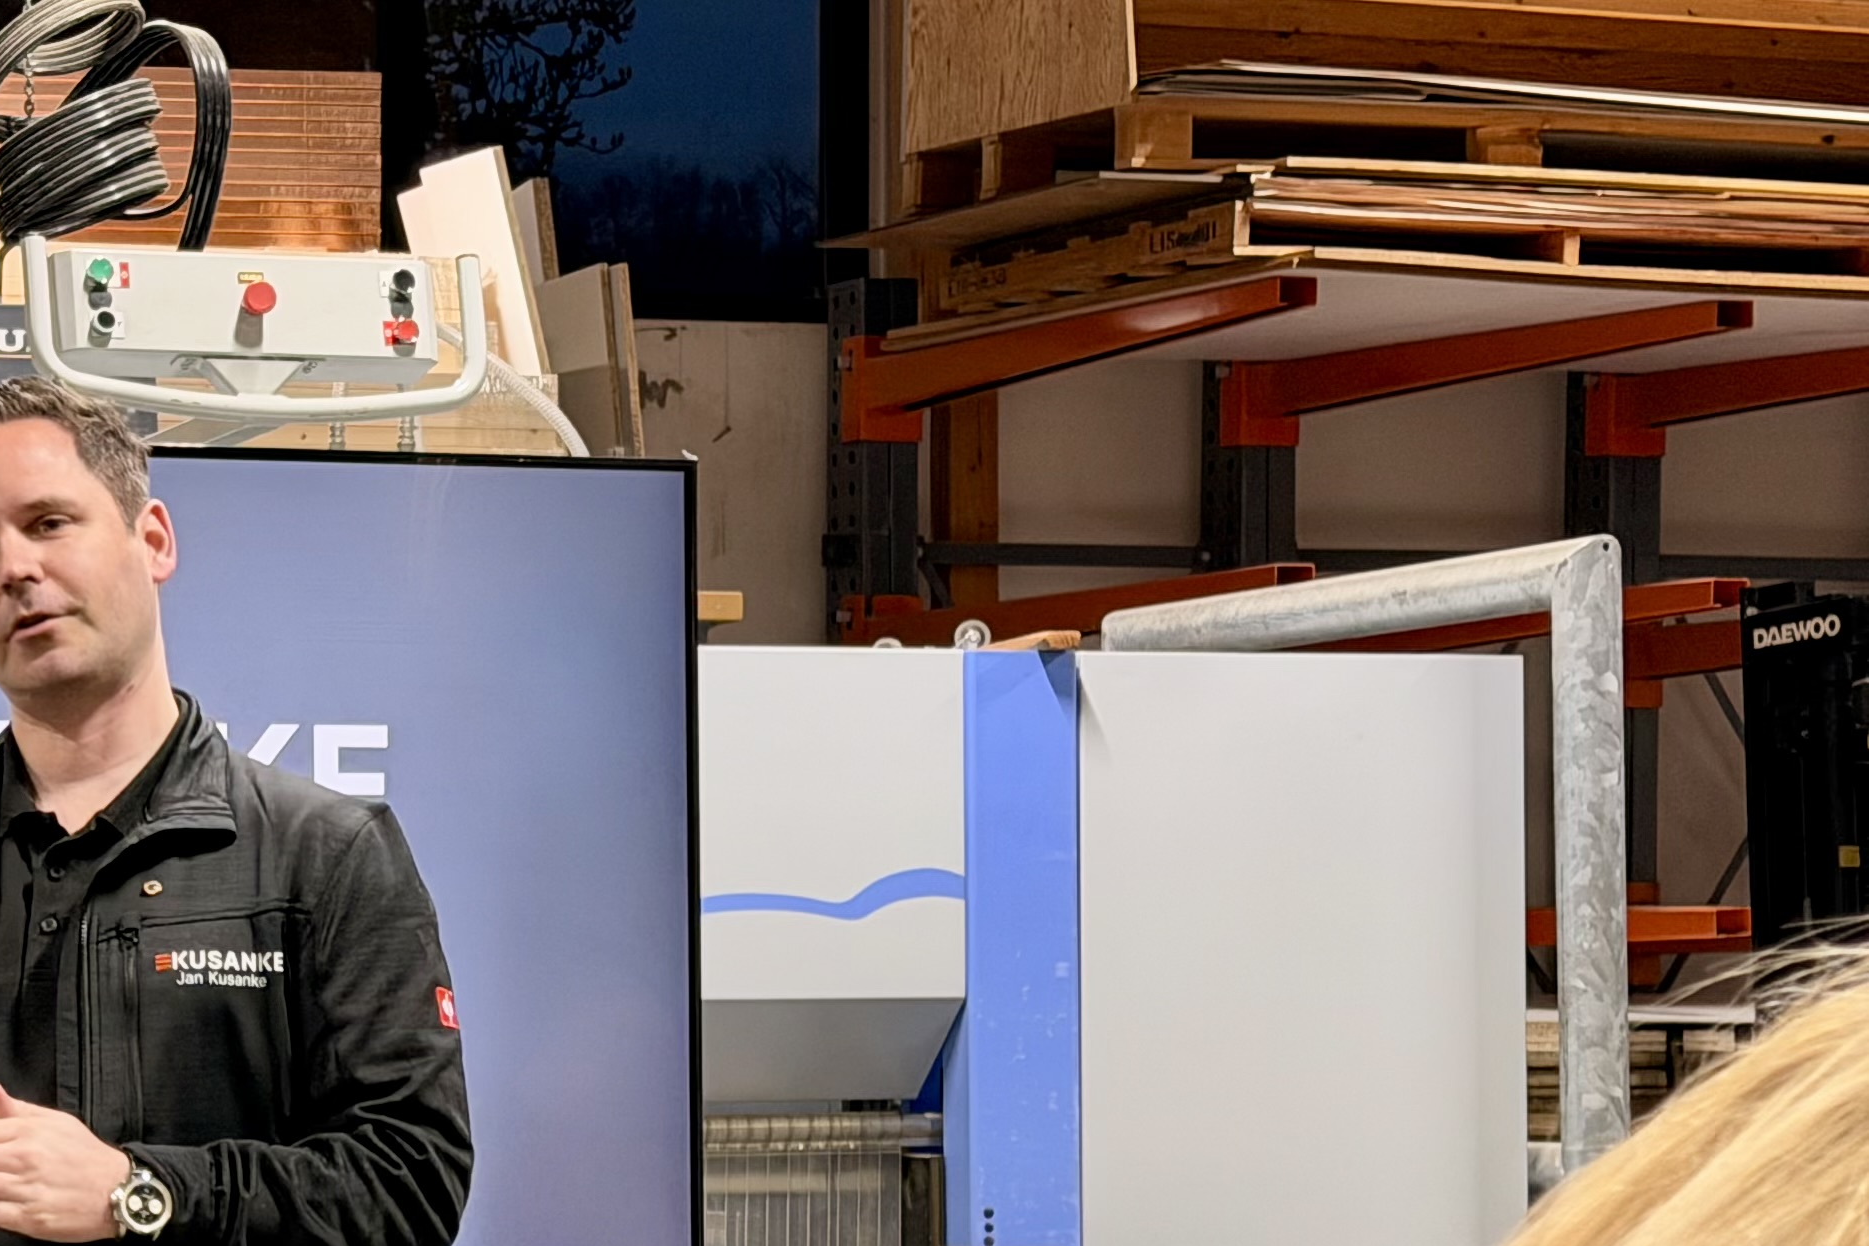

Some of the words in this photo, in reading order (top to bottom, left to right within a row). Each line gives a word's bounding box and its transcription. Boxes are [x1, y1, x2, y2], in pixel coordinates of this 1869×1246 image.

[1753, 613, 1841, 649] DAEWOO
[171, 950, 284, 972] KUSANKE
[176, 970, 204, 985] Jan
[208, 970, 267, 988] Kusanke
